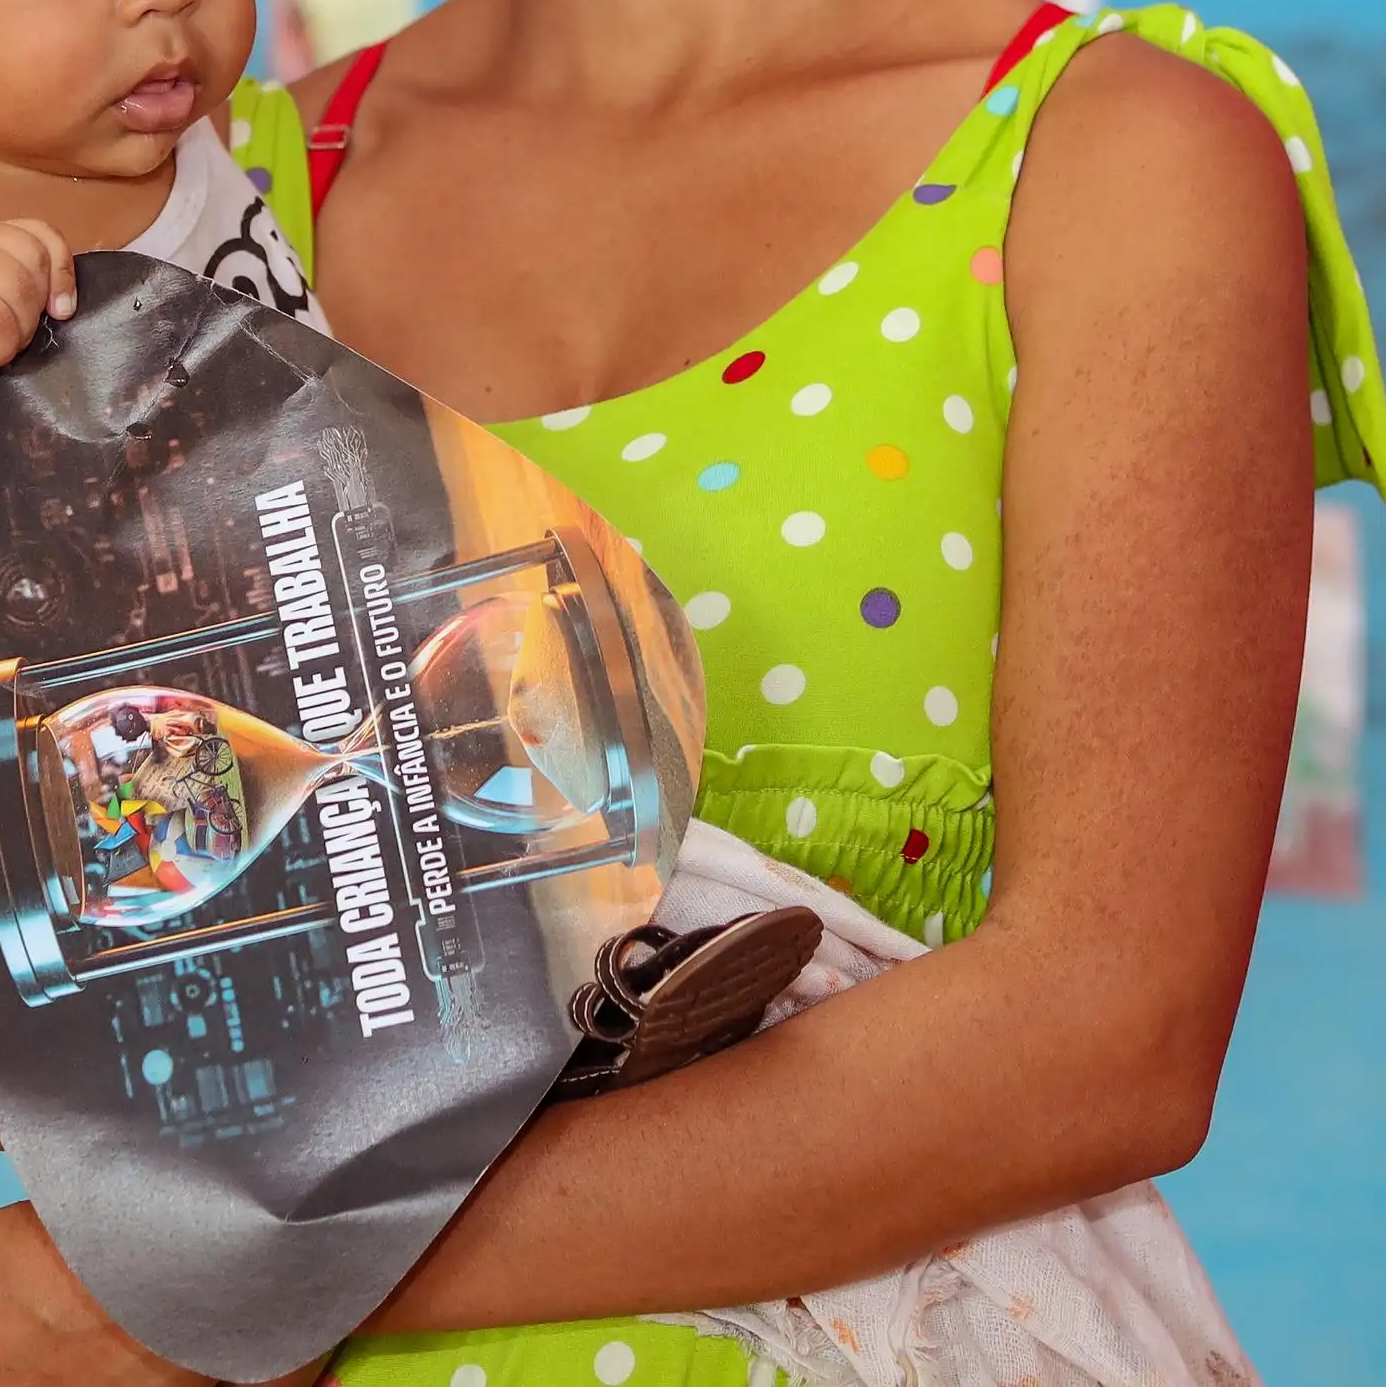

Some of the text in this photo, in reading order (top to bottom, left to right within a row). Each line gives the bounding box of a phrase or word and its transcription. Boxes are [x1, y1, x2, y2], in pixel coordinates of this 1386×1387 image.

[254, 479, 414, 1038] TODA CRIANÇA QUE TRABALHA
[359, 563, 456, 916] PERDE A INFÂNCIA E O FUTURO
